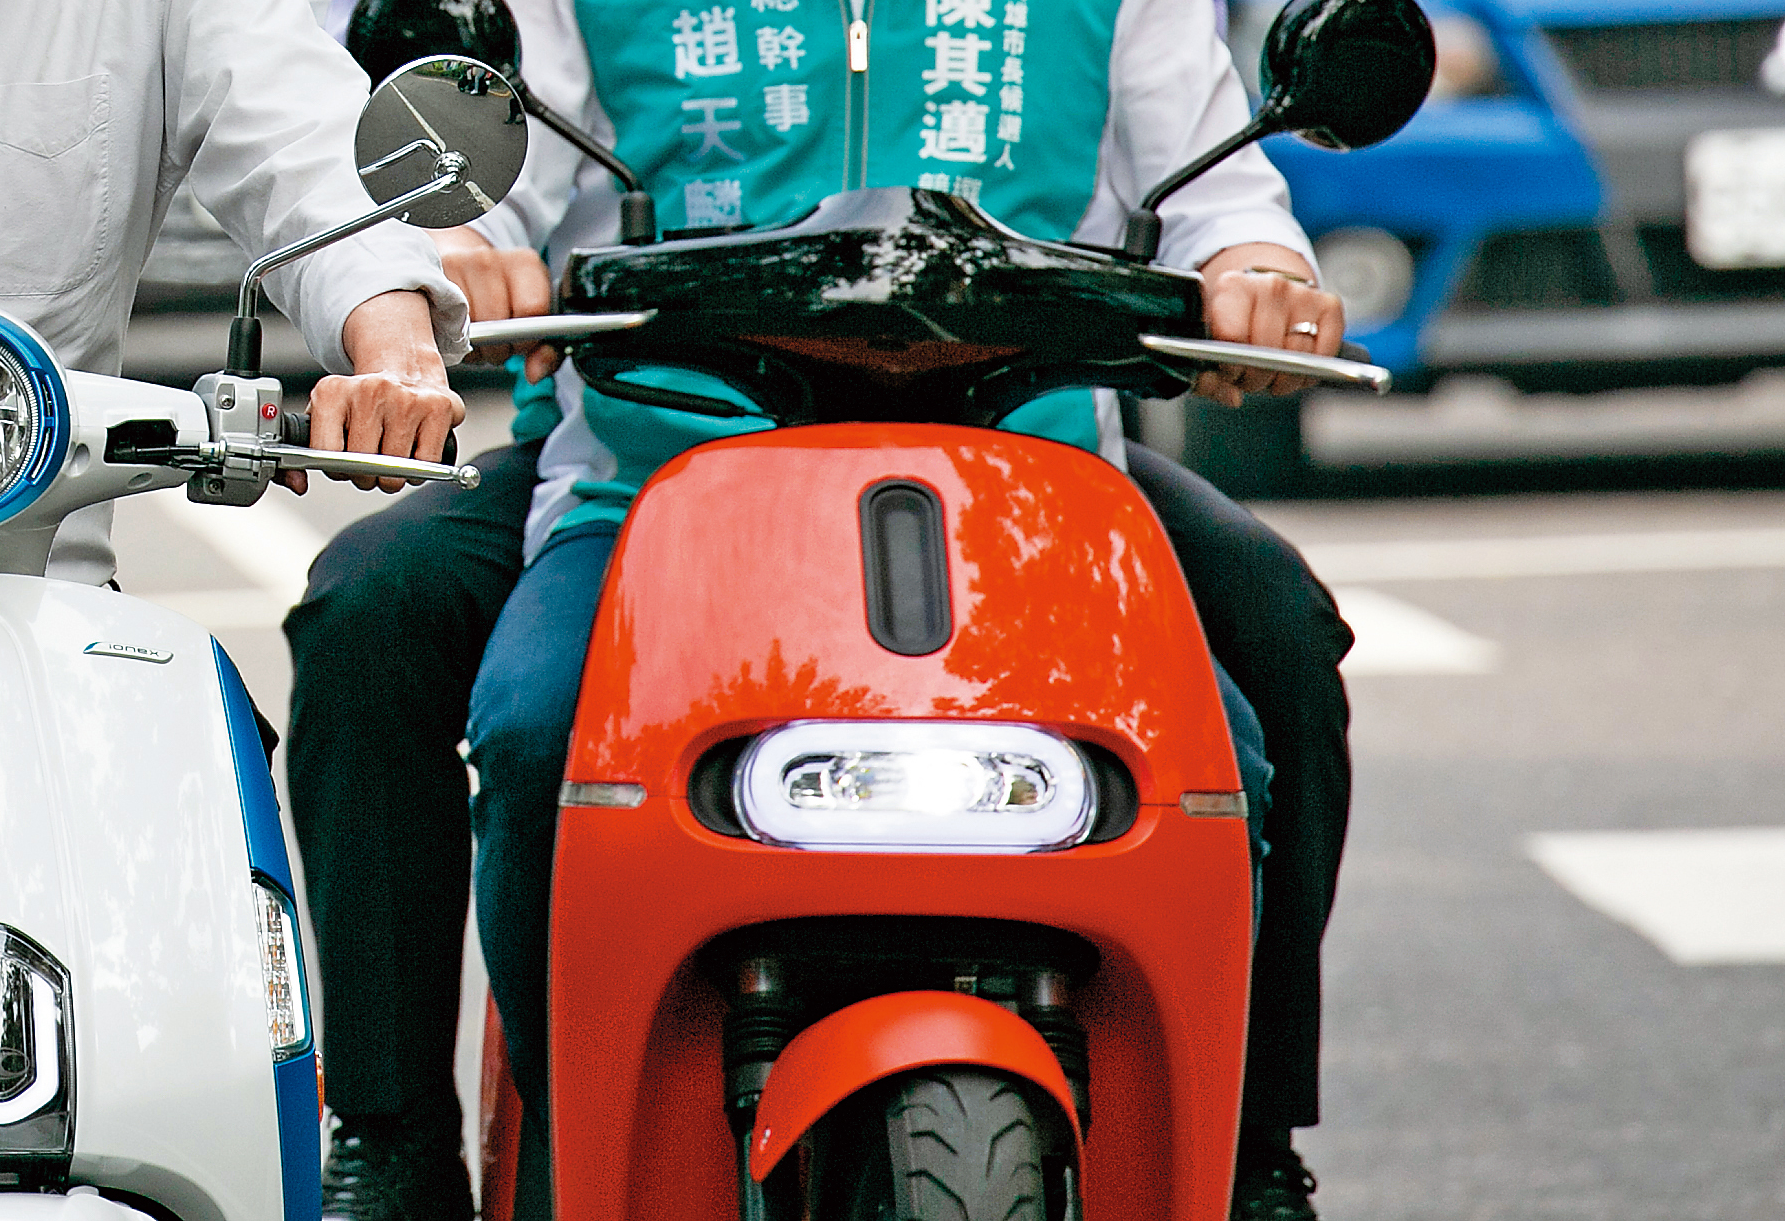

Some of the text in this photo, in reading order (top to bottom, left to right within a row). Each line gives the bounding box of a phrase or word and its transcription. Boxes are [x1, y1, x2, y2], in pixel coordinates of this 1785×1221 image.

[672, 5, 745, 229] 趙天麟
[267, 405, 276, 417] R
[108, 643, 160, 658] ionex
